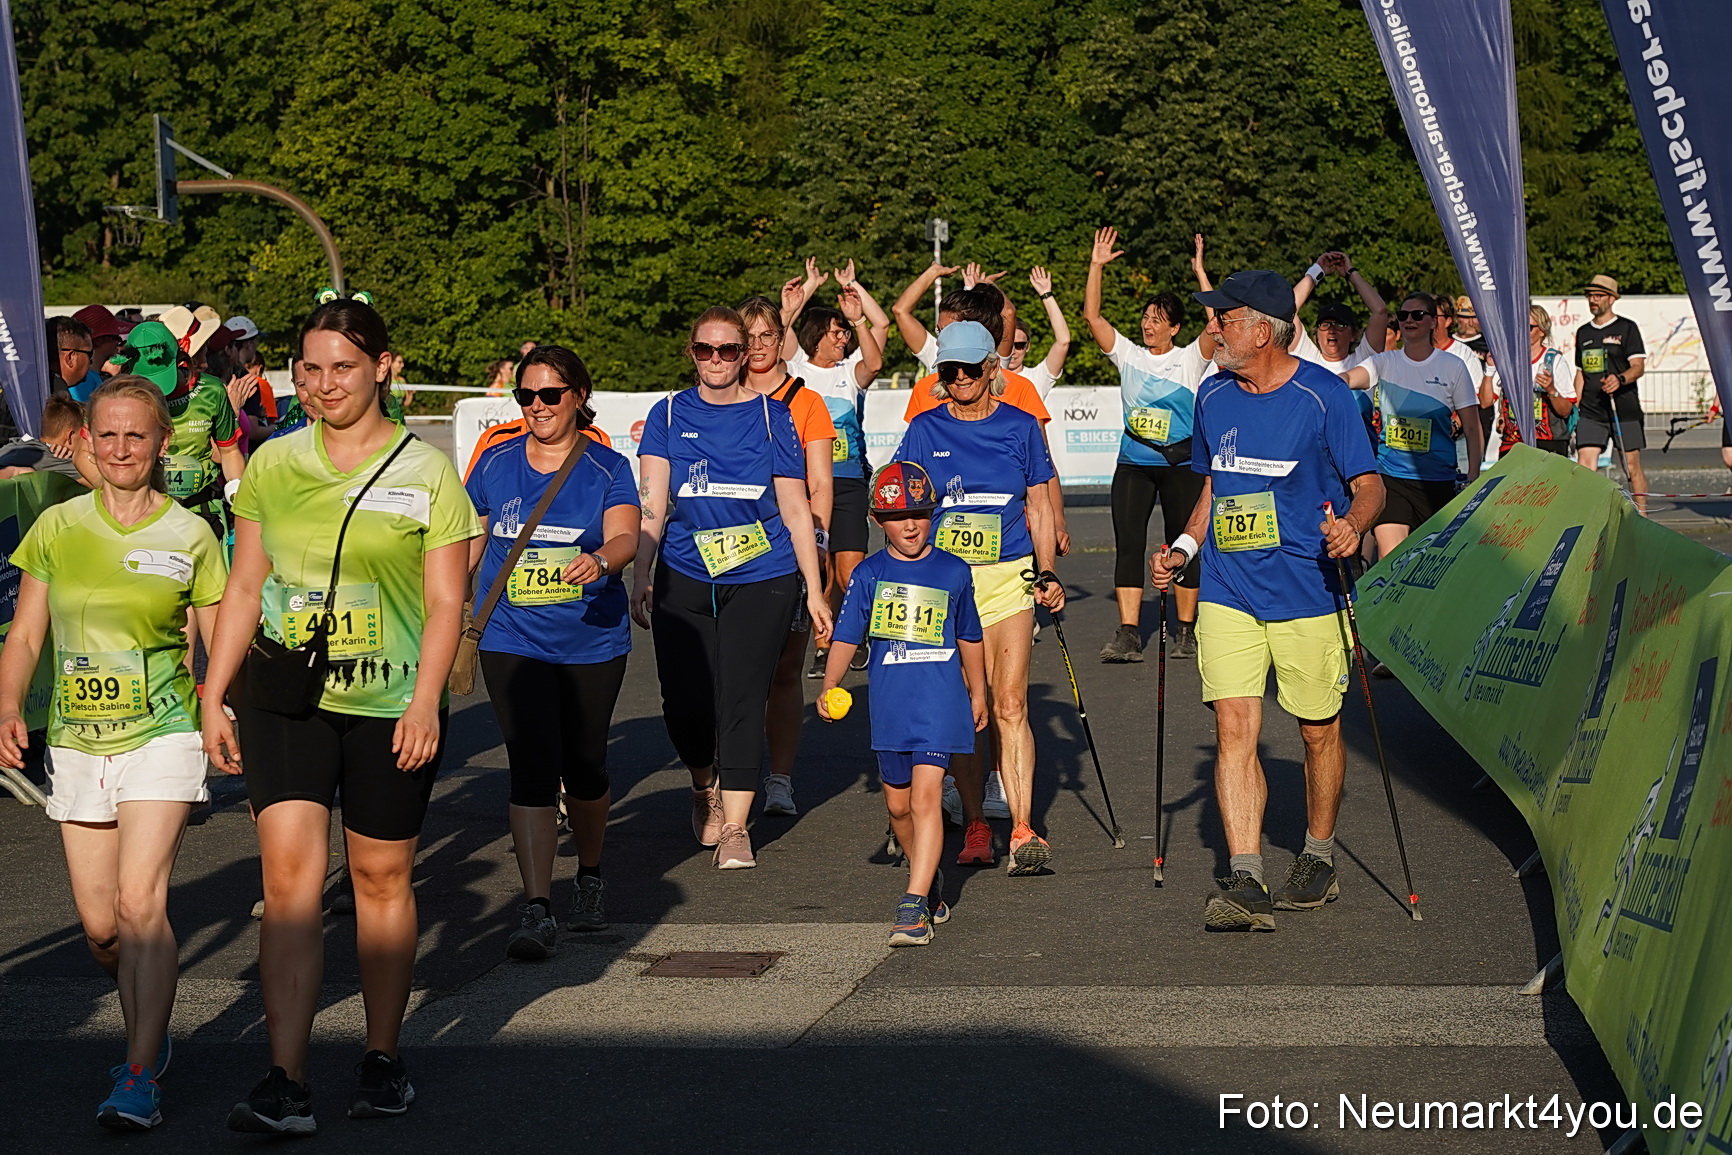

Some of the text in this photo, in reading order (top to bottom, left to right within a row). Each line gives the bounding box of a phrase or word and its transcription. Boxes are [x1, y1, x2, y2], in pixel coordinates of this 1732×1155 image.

[1064, 408, 1098, 420] NOW
[1134, 417, 1162, 430] 1214
[1067, 431, 1117, 443] E-BIKES
[1394, 426, 1422, 441] 1201
[932, 450, 950, 458] JAKO
[1239, 460, 1284, 469] Schornsteintechnik
[1226, 513, 1257, 533] 787
[1266, 514, 1275, 539] 2022
[536, 528, 572, 536] nsteintechnik
[951, 530, 984, 548] 790
[1248, 532, 1266, 540] Erich
[738, 542, 758, 555] Andrea
[990, 534, 998, 558] 2022
[169, 555, 192, 568] Klinikum
[704, 547, 718, 570] WALK
[524, 567, 562, 586] 784
[518, 588, 542, 596] Dobner
[874, 602, 884, 630] WALK
[886, 602, 933, 626] 1341
[367, 613, 377, 646] 2022
[912, 625, 928, 633] Emil
[934, 612, 944, 638] 2022
[342, 637, 366, 645] Karin
[75, 677, 119, 700] 399
[132, 680, 142, 711] 2022
[71, 702, 130, 711] Pietsch Sabine
